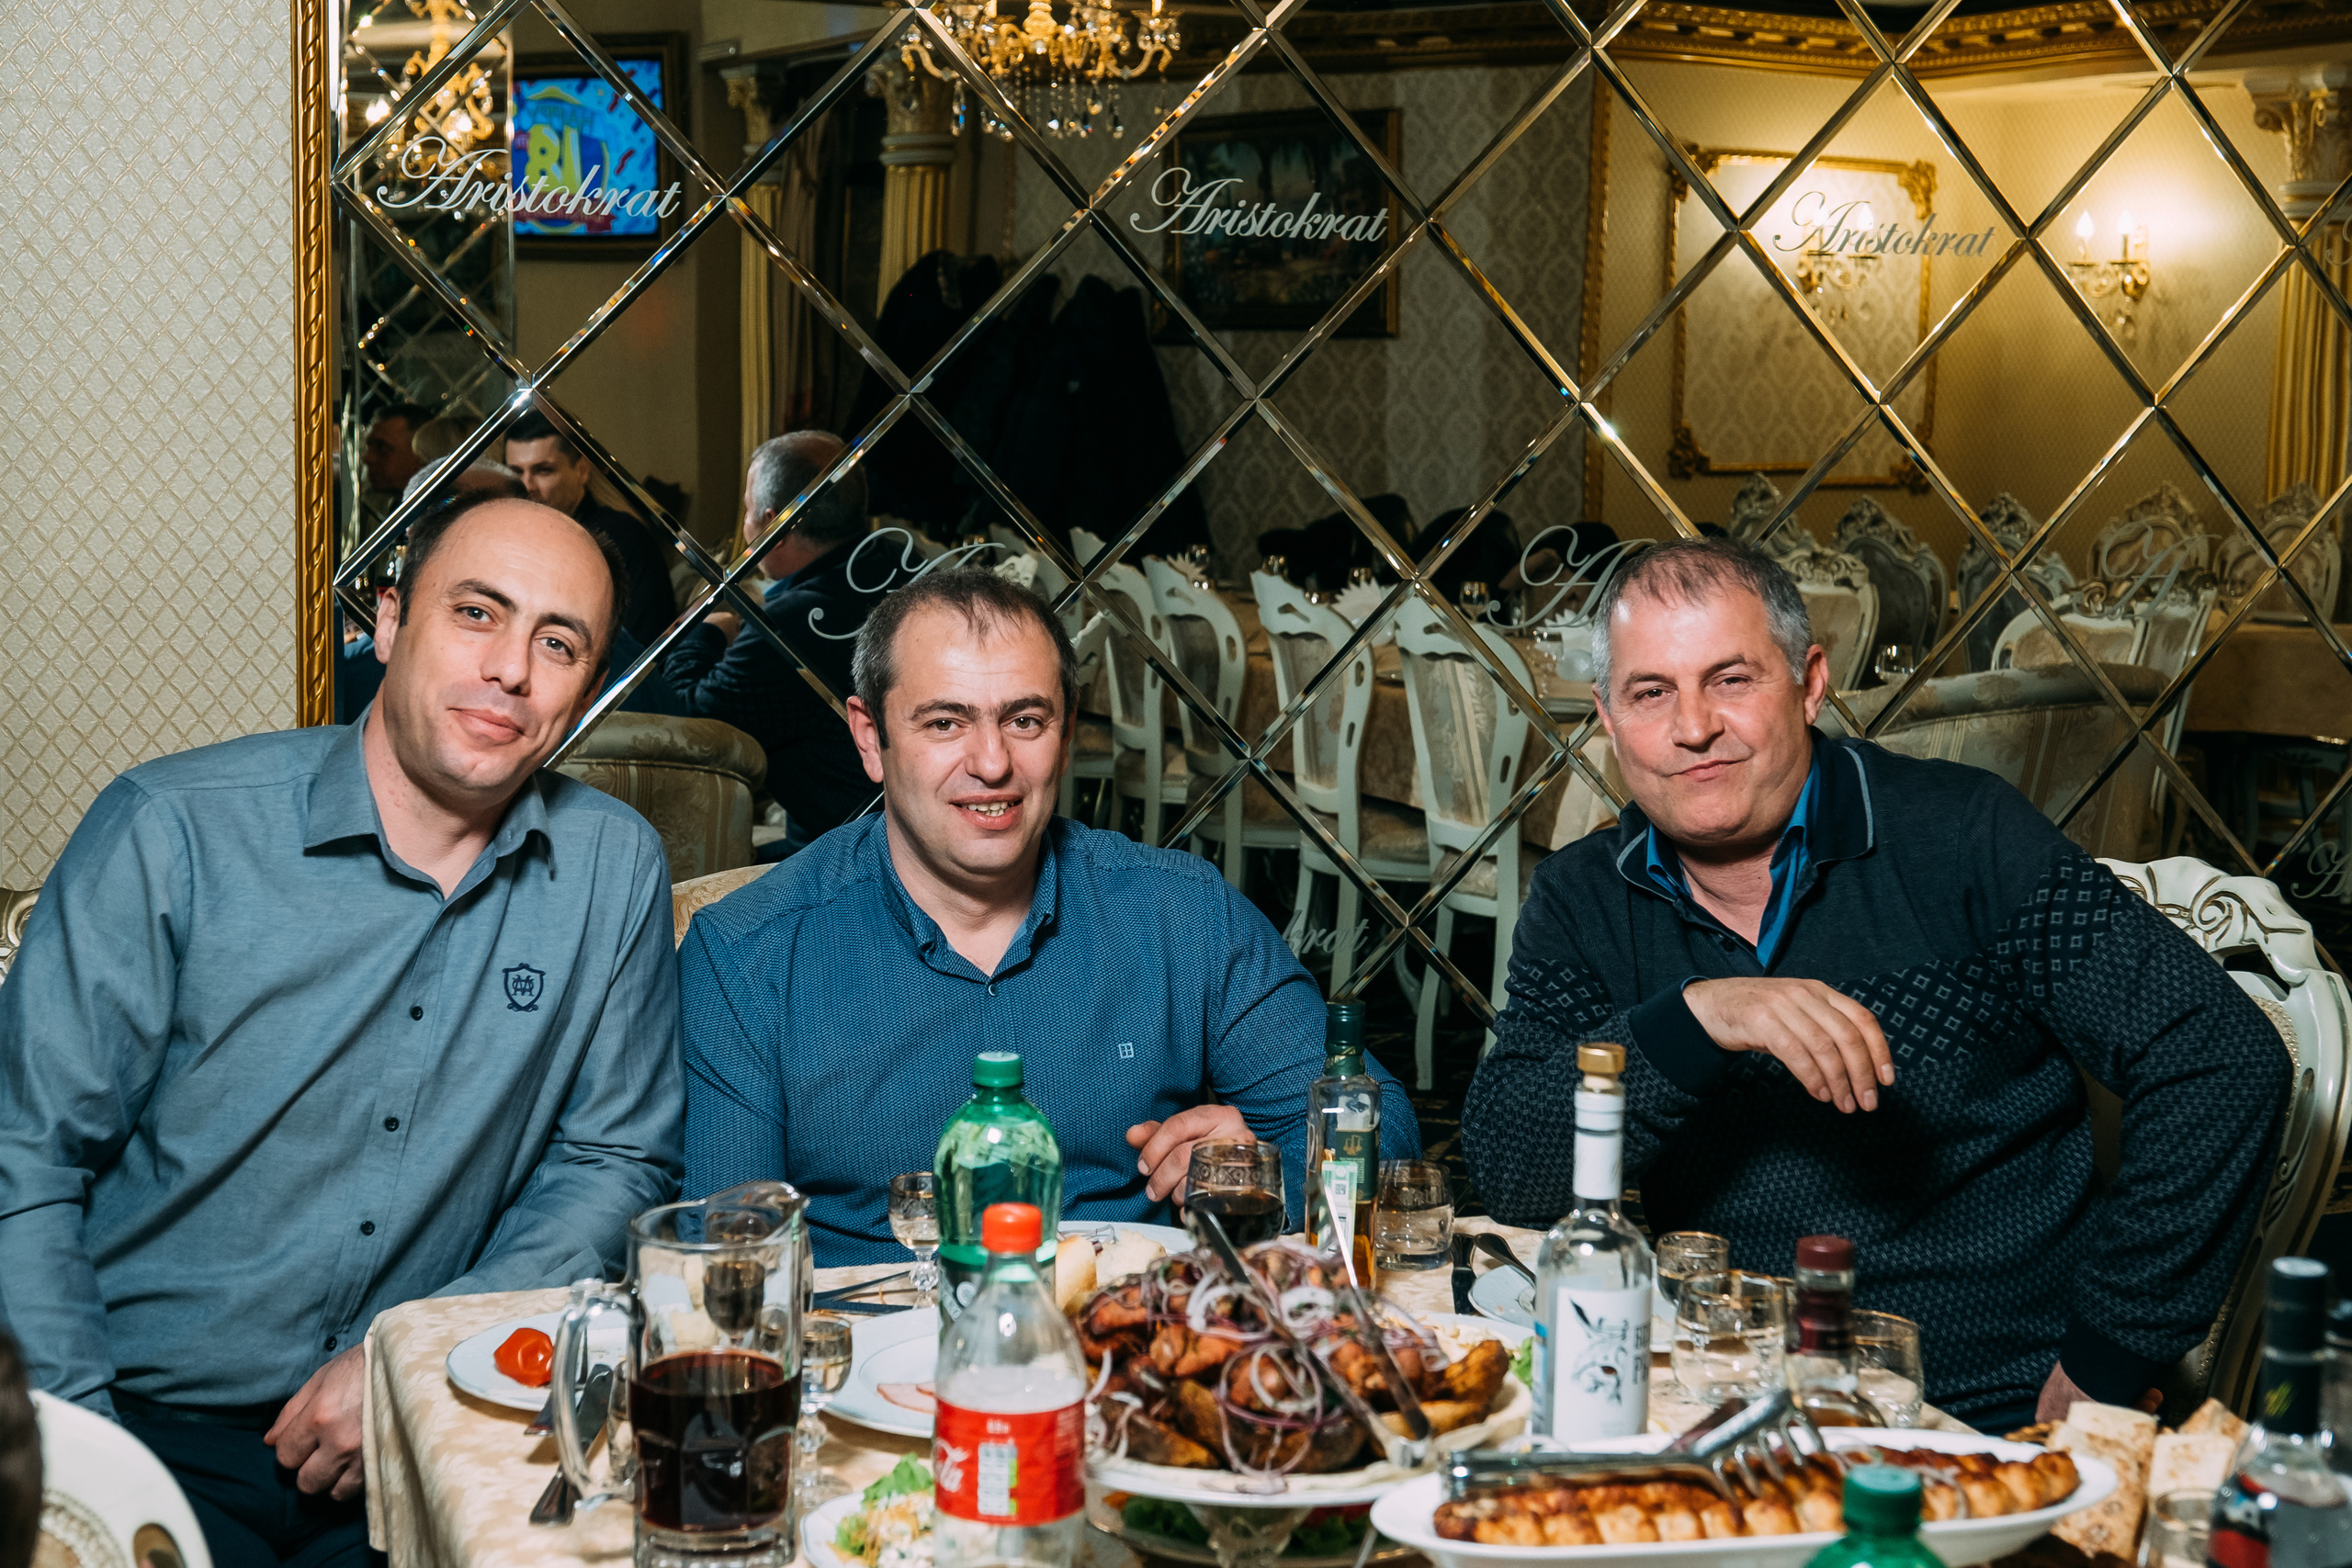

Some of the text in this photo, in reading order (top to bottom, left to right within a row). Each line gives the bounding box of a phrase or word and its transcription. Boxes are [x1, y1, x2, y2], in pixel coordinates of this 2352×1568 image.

[377, 136, 682, 220] Aristokrat
[1129, 166, 1389, 243] Aristokrat
[1772, 190, 1995, 258] Aristokrat
